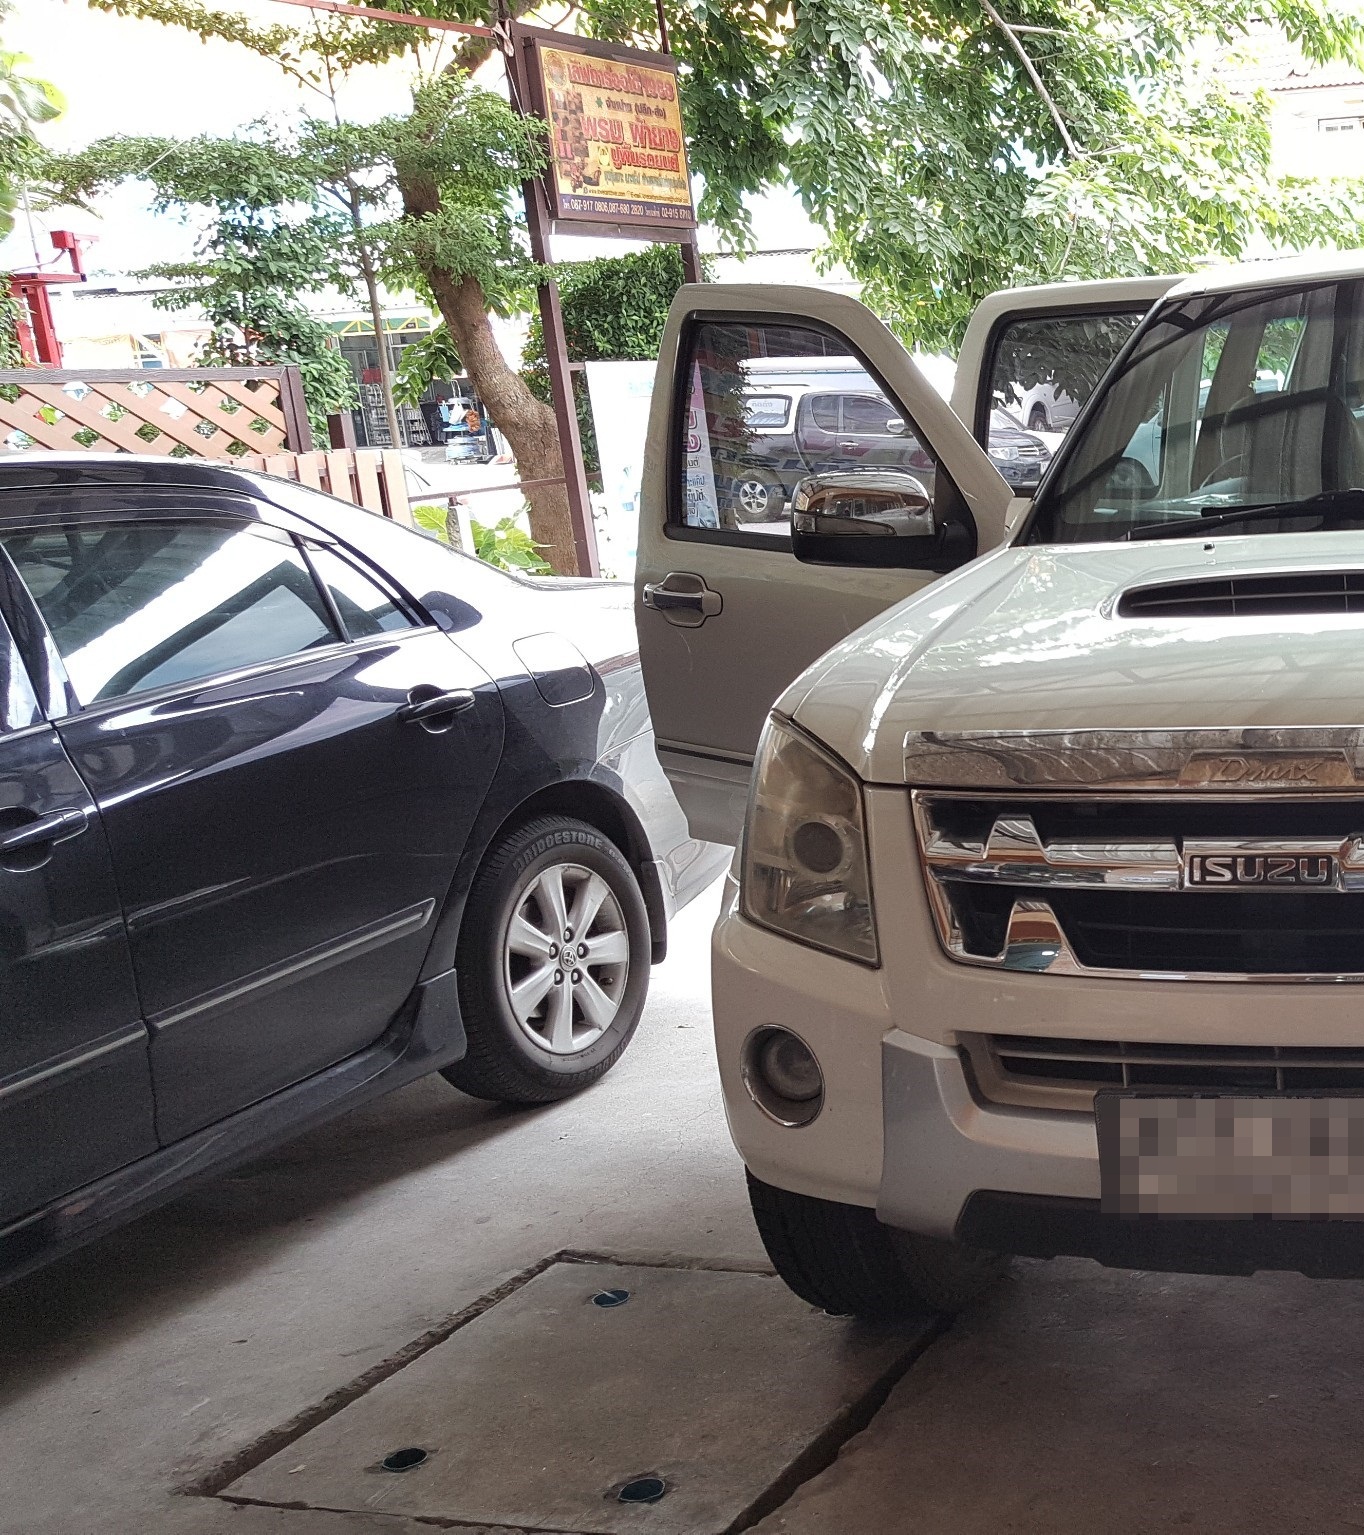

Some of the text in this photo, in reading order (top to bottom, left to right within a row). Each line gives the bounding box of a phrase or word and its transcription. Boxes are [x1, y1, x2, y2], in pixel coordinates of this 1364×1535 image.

[580, 115, 625, 145] พรม
[610, 142, 680, 172] ปูพื้นรถยนต์
[570, 198, 594, 211] 087-917
[512, 830, 604, 878] BRIDGESTONE
[1192, 856, 1328, 883] ISUZU
